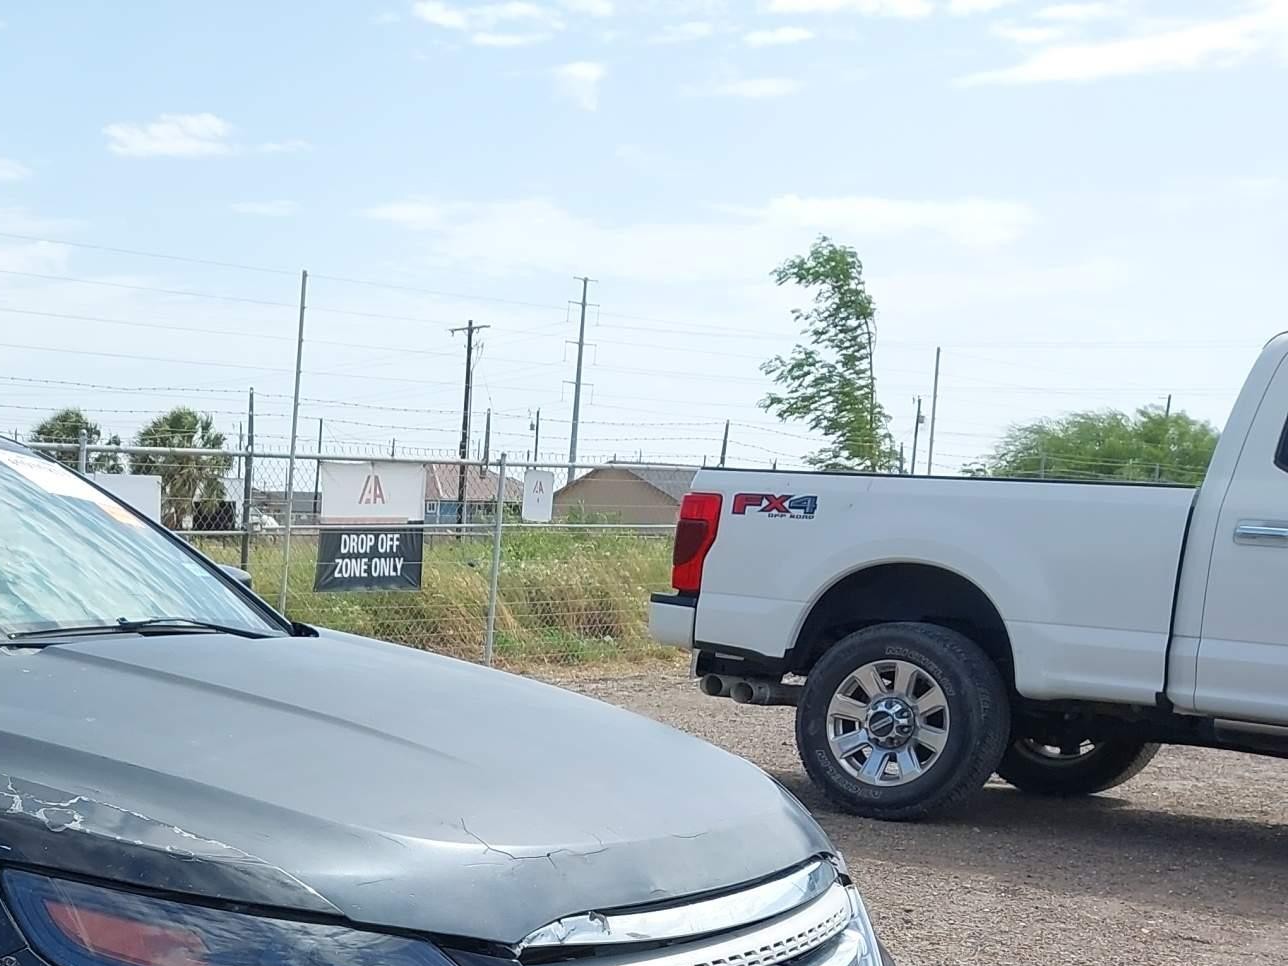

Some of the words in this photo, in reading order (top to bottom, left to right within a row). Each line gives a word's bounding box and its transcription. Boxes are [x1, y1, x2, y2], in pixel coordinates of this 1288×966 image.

[731, 492, 818, 515] FX4
[340, 533, 375, 554] DROP
[377, 533, 401, 553] OFF
[334, 557, 369, 578] ZONE
[371, 556, 404, 578] ONLY
